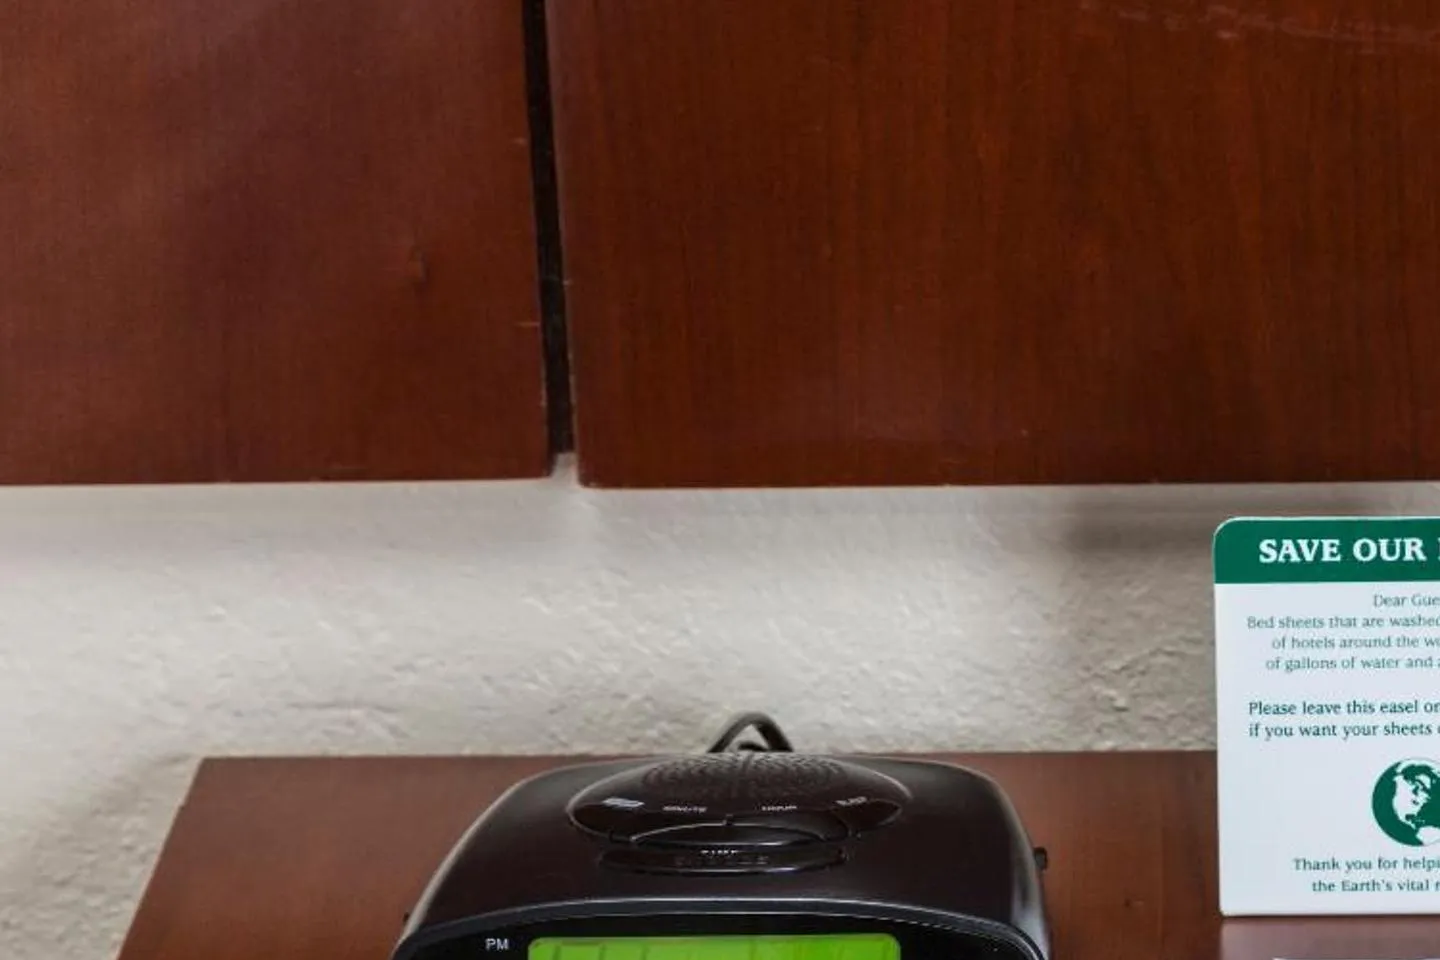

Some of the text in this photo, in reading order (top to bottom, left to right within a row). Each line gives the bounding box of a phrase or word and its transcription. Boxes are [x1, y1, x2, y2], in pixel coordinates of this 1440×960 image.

[1258, 538, 1342, 564] SAVE
[1352, 537, 1427, 562] OUR
[1373, 594, 1407, 608] Dear
[1247, 615, 1275, 629] Bed
[1278, 616, 1325, 629] sheets
[1328, 616, 1358, 629] that
[1361, 617, 1385, 628] are
[1271, 636, 1286, 650] of
[1291, 636, 1336, 649] hotels
[1339, 636, 1393, 649] around
[1396, 635, 1420, 648] the
[1265, 656, 1281, 671] of
[1284, 656, 1338, 673] gallons
[1341, 655, 1356, 670] of
[1360, 657, 1400, 670] water
[1405, 656, 1434, 669] and
[1248, 700, 1298, 715] Please
[1302, 700, 1342, 715] leave
[1346, 699, 1376, 714] this
[1379, 700, 1418, 714] easel
[1248, 722, 1261, 738] if
[1264, 726, 1294, 741] you
[1299, 724, 1338, 738] want
[1342, 725, 1380, 740] your
[1383, 721, 1433, 737] sheets
[1293, 857, 1341, 871] Thank
[1344, 860, 1373, 874] you
[1377, 856, 1399, 870] for
[1311, 879, 1336, 893] the
[1340, 879, 1393, 892] Earth's
[1396, 879, 1430, 892] vital
[485, 938, 509, 951] PM
